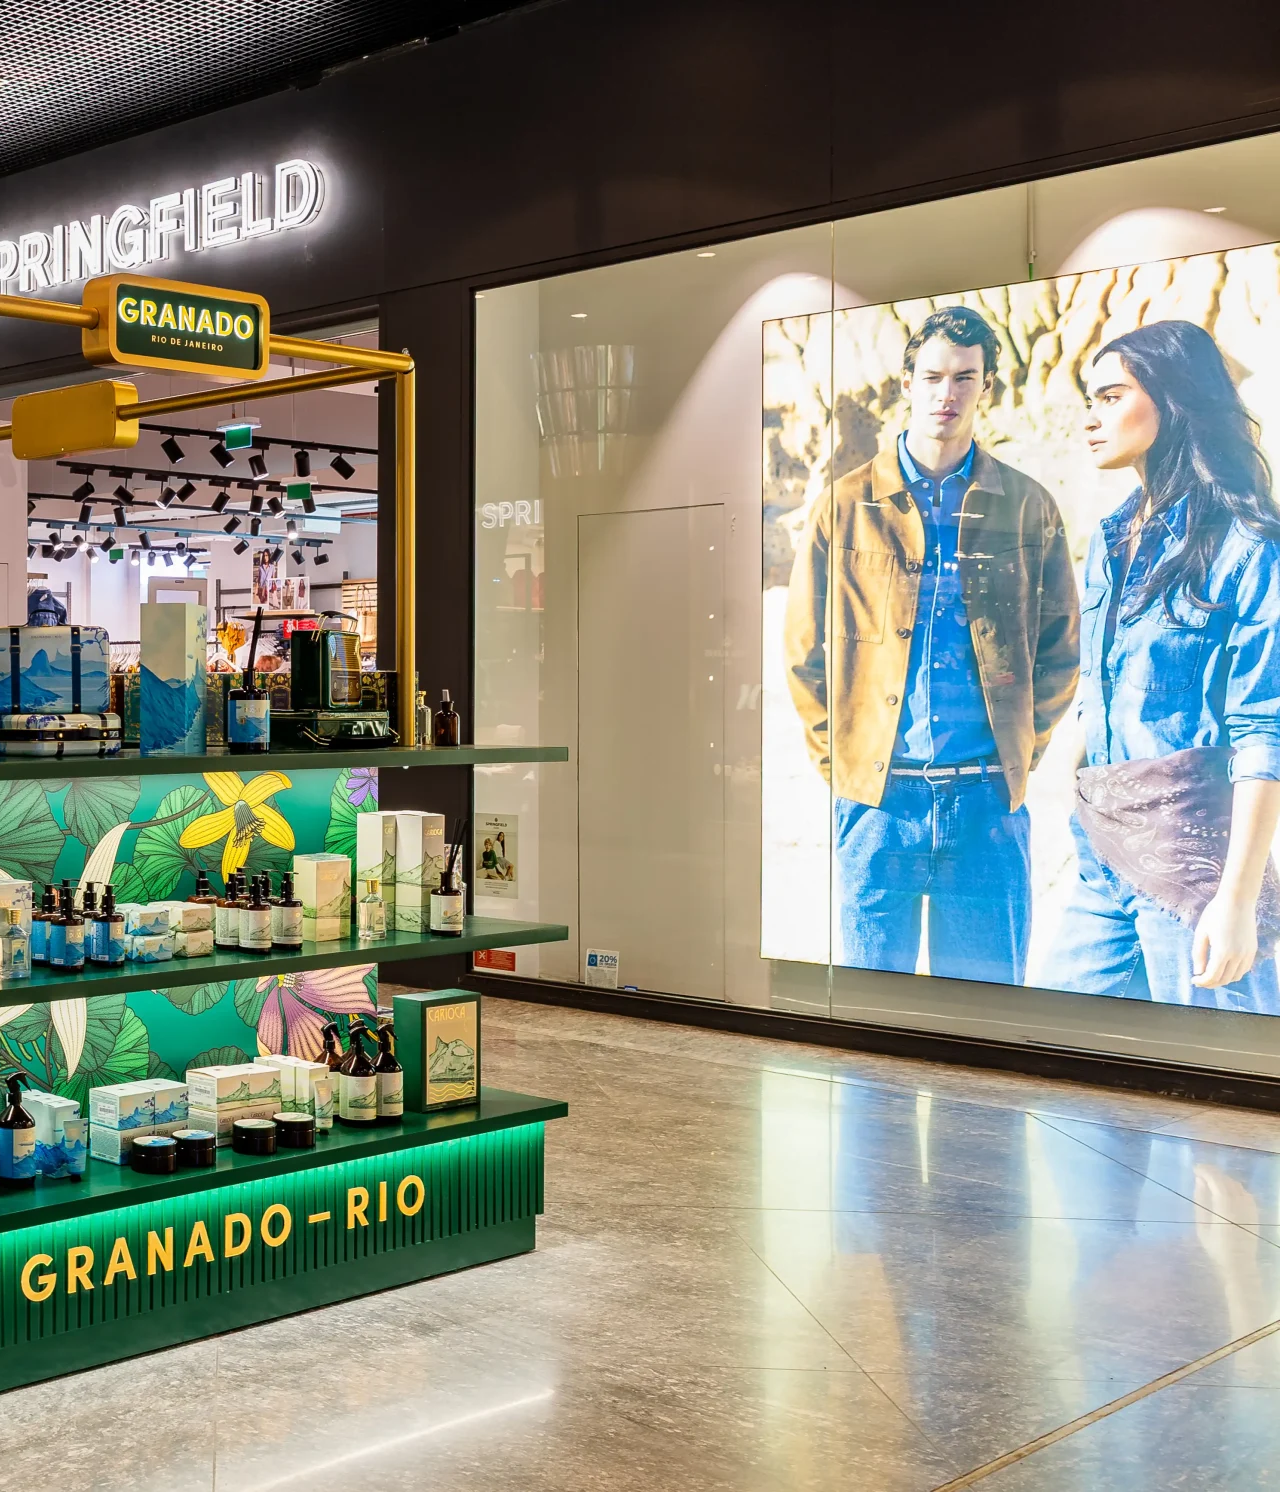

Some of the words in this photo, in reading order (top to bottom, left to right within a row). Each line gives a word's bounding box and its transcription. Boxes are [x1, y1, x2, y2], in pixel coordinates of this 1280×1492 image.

[118, 297, 254, 340] GRANADO
[151, 334, 166, 343] RIO
[170, 338, 181, 346] DE
[184, 339, 224, 352] JANEIRO
[599, 955, 618, 964] 20%
[428, 1005, 466, 1022] CARIOCA
[21, 1203, 293, 1302] GRANADO
[346, 1174, 425, 1230] RIO
